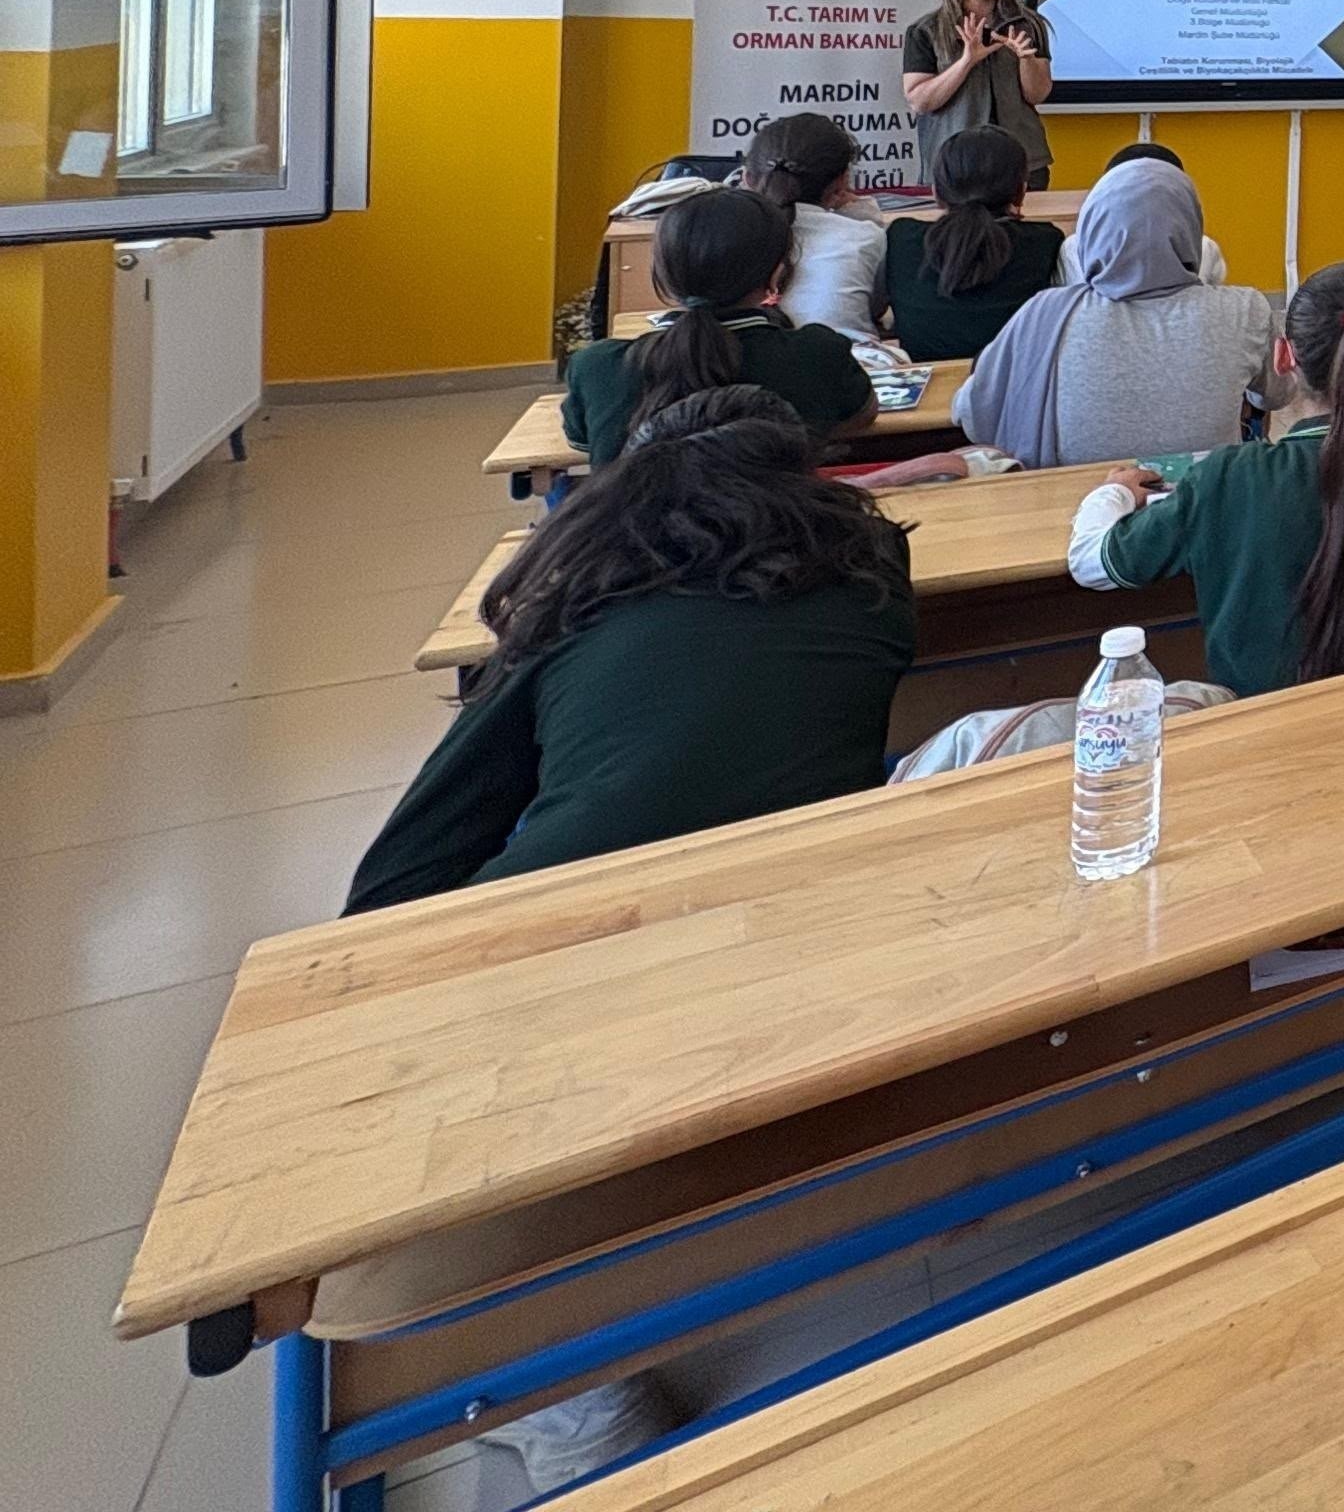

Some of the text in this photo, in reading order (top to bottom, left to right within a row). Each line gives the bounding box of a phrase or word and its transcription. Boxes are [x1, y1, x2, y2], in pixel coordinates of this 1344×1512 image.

[766, 5, 898, 24] T.C. TARIM VE
[732, 32, 904, 50] ORMAN BAKANLI
[779, 79, 880, 104] MARDİN
[712, 112, 771, 138] DOĞ
[832, 113, 902, 132] RUMA
[857, 141, 914, 162] KLAR
